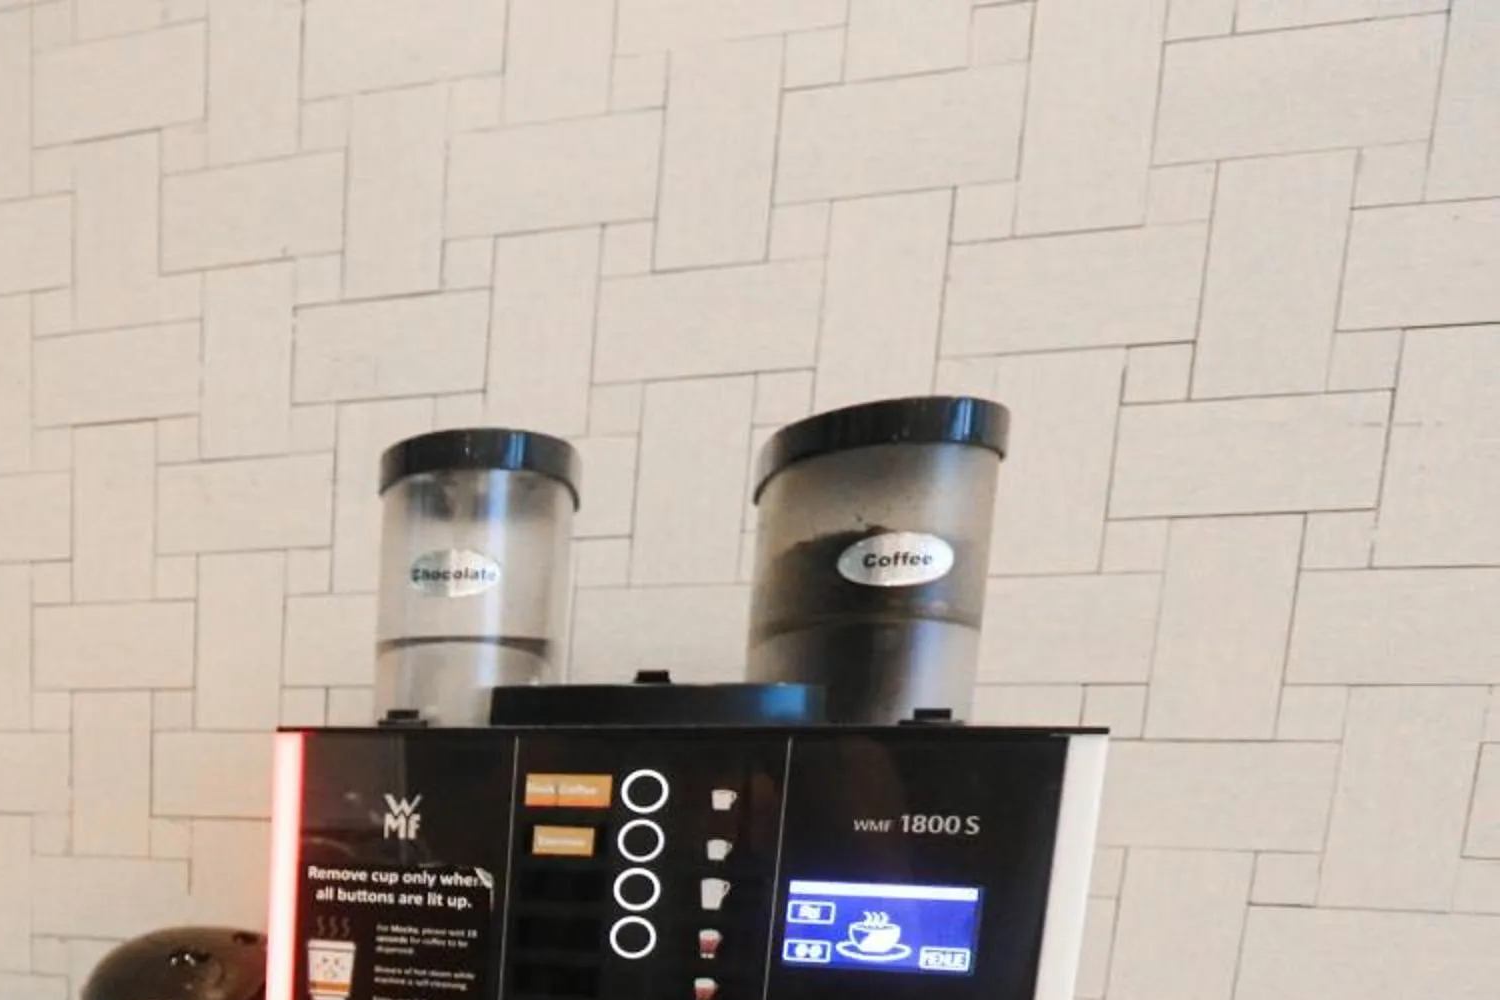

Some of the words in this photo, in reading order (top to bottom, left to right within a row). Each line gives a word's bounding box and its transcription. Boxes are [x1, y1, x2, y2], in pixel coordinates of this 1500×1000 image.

[863, 552, 933, 568] Coffee
[411, 566, 499, 582] Chocolate
[853, 819, 891, 832] WMF
[901, 814, 961, 834] 1800
[964, 815, 980, 834] S
[308, 865, 367, 881] Remove
[371, 871, 398, 884] cup
[402, 871, 435, 887] only
[315, 886, 333, 900] all
[337, 888, 394, 904] buttons
[398, 893, 423, 905] are
[427, 892, 443, 907] lit
[447, 898, 472, 910] up.
